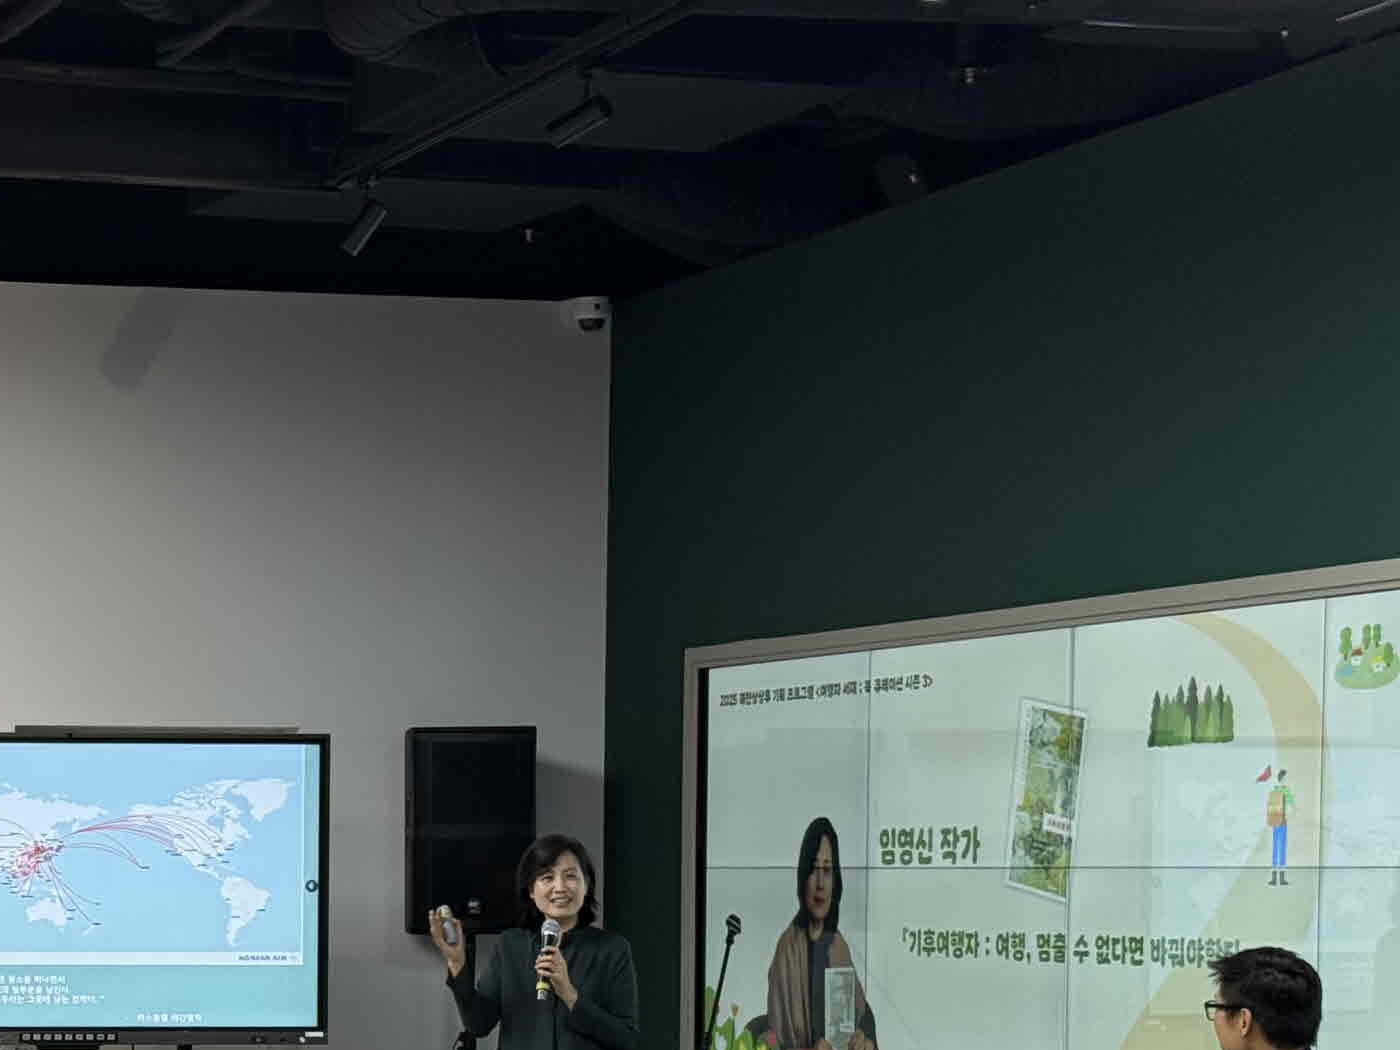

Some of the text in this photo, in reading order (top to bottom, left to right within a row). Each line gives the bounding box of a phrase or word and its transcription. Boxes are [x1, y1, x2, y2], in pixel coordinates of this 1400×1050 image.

[879, 826, 981, 865] 임영신 작가
[996, 932, 1032, 964] 여행,
[1036, 933, 1066, 964] 멈출
[1073, 934, 1091, 964] 수
[1095, 934, 1144, 966] 없다면
